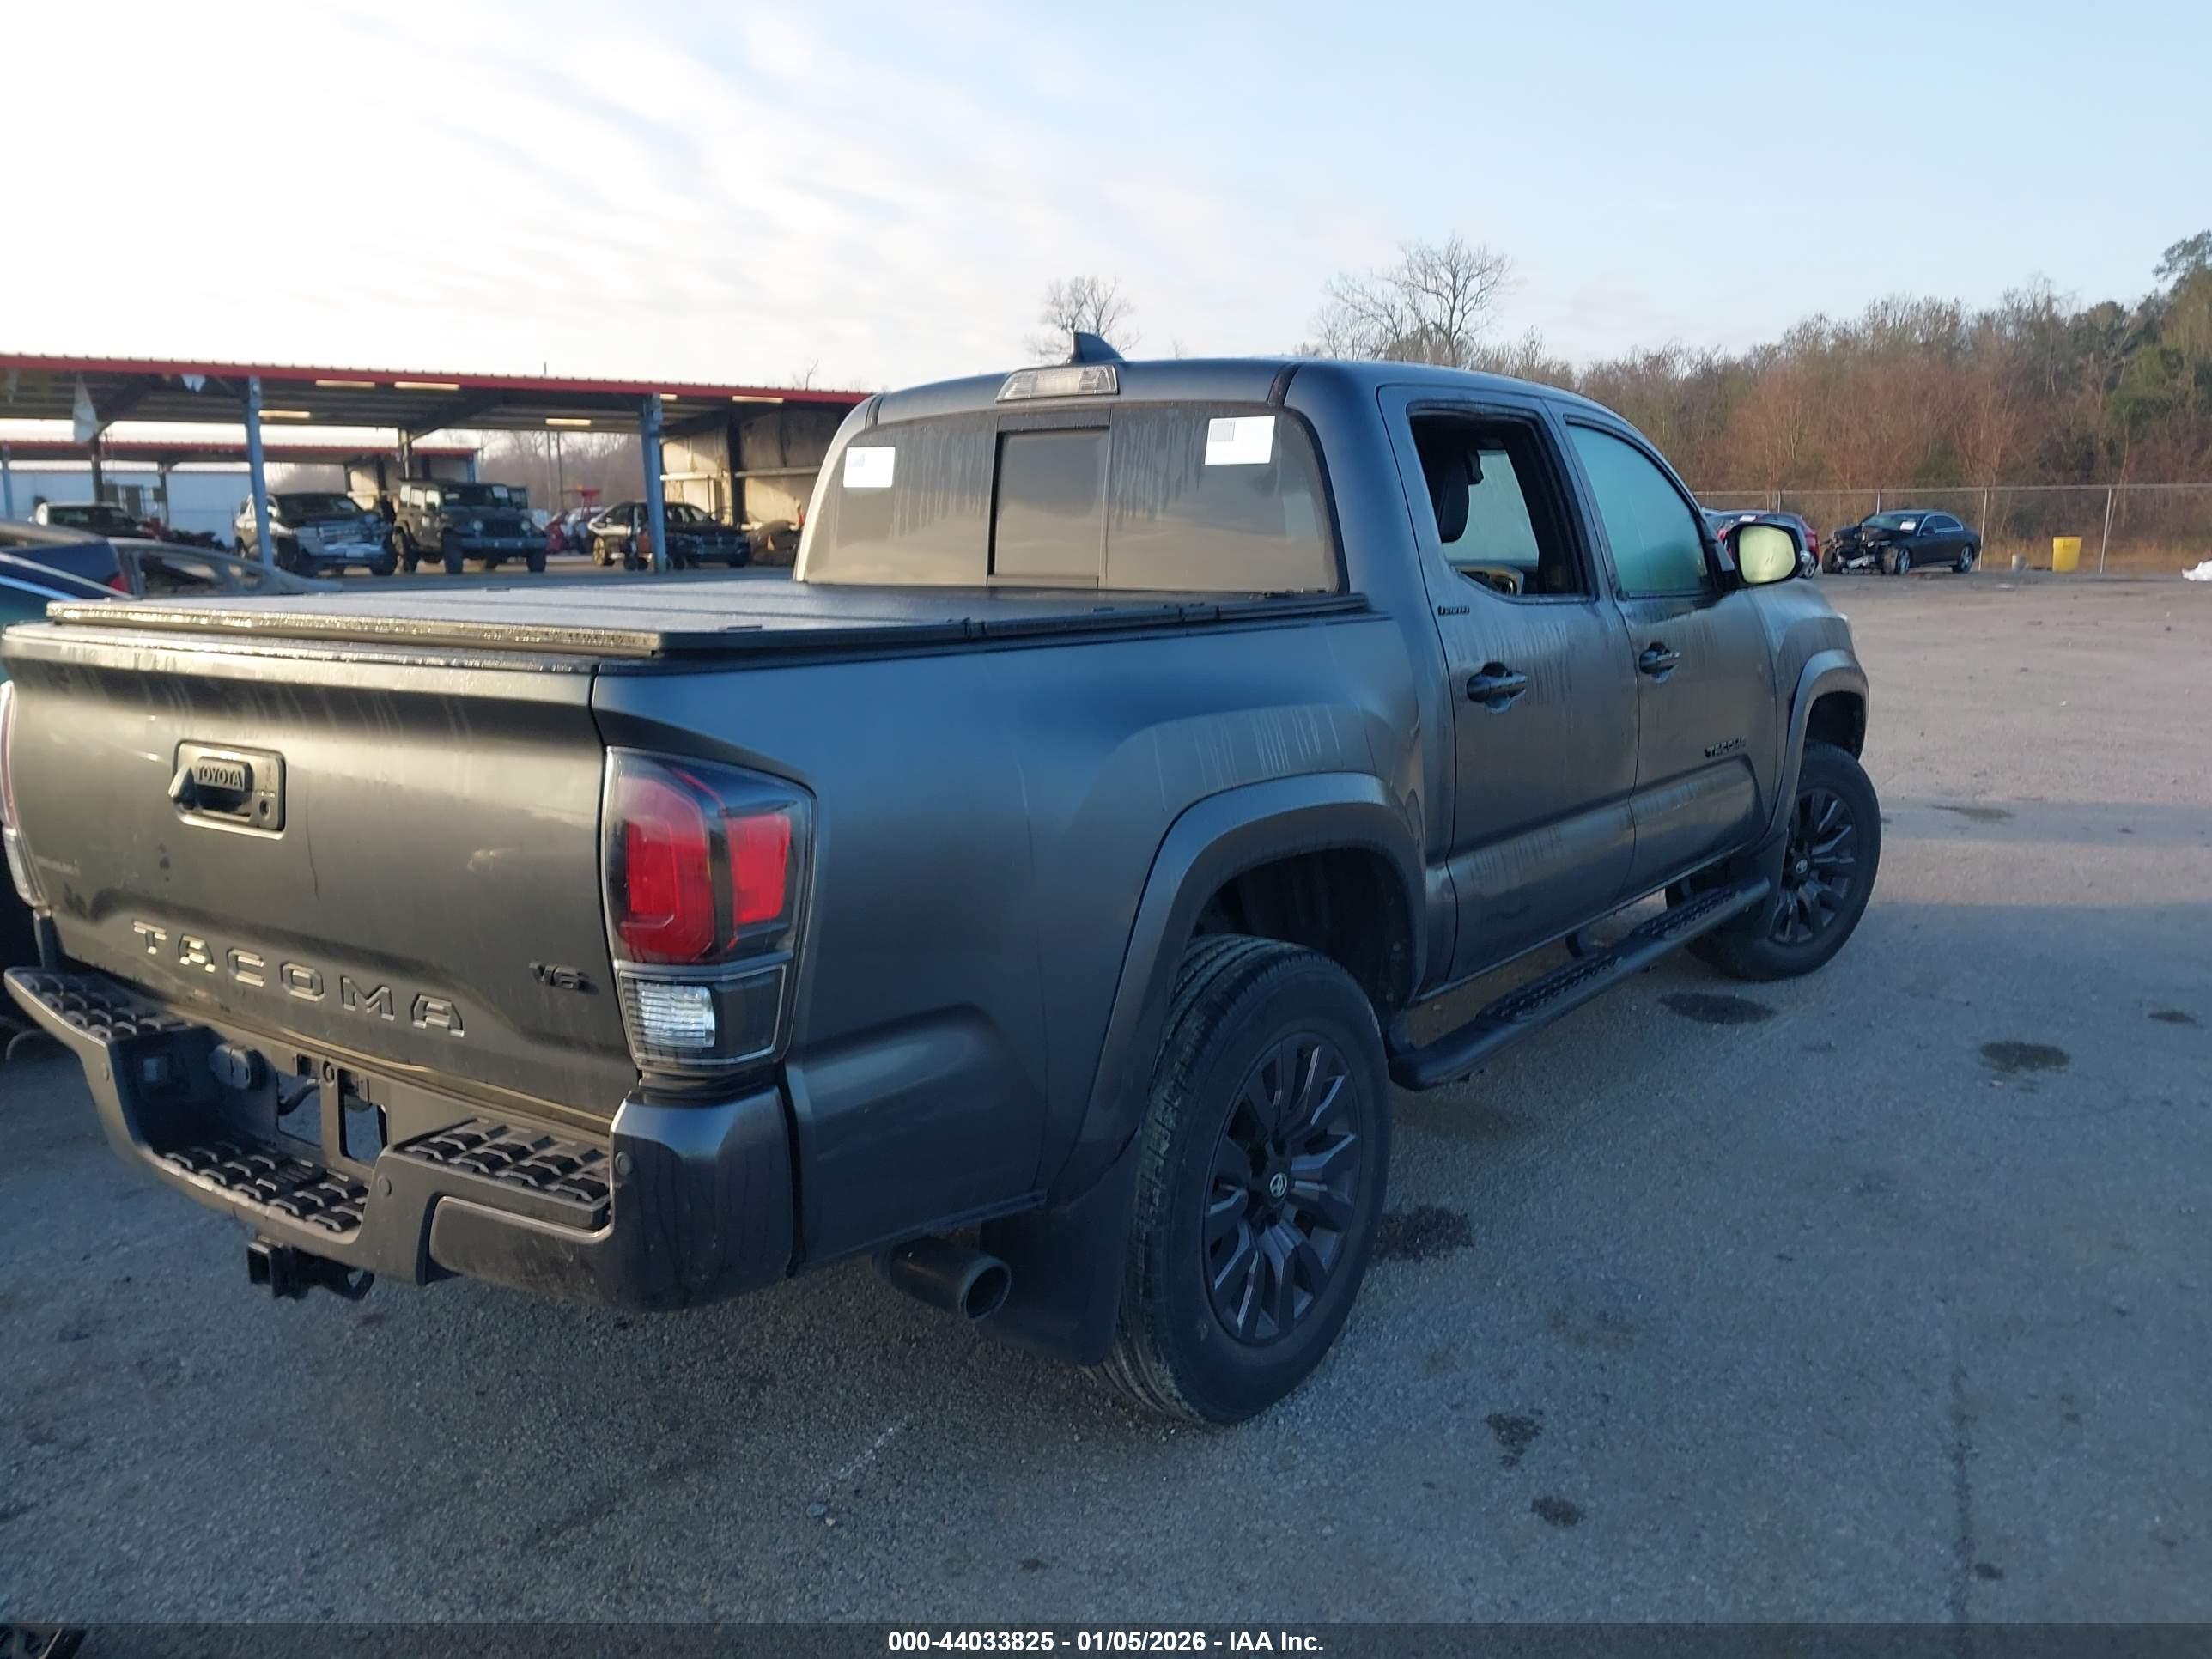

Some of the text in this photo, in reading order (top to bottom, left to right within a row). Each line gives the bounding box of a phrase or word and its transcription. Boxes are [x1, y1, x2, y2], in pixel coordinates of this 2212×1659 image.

[198, 765, 244, 788] TOYOTA
[132, 919, 465, 1037] TACOMA
[528, 962, 578, 989] V6
